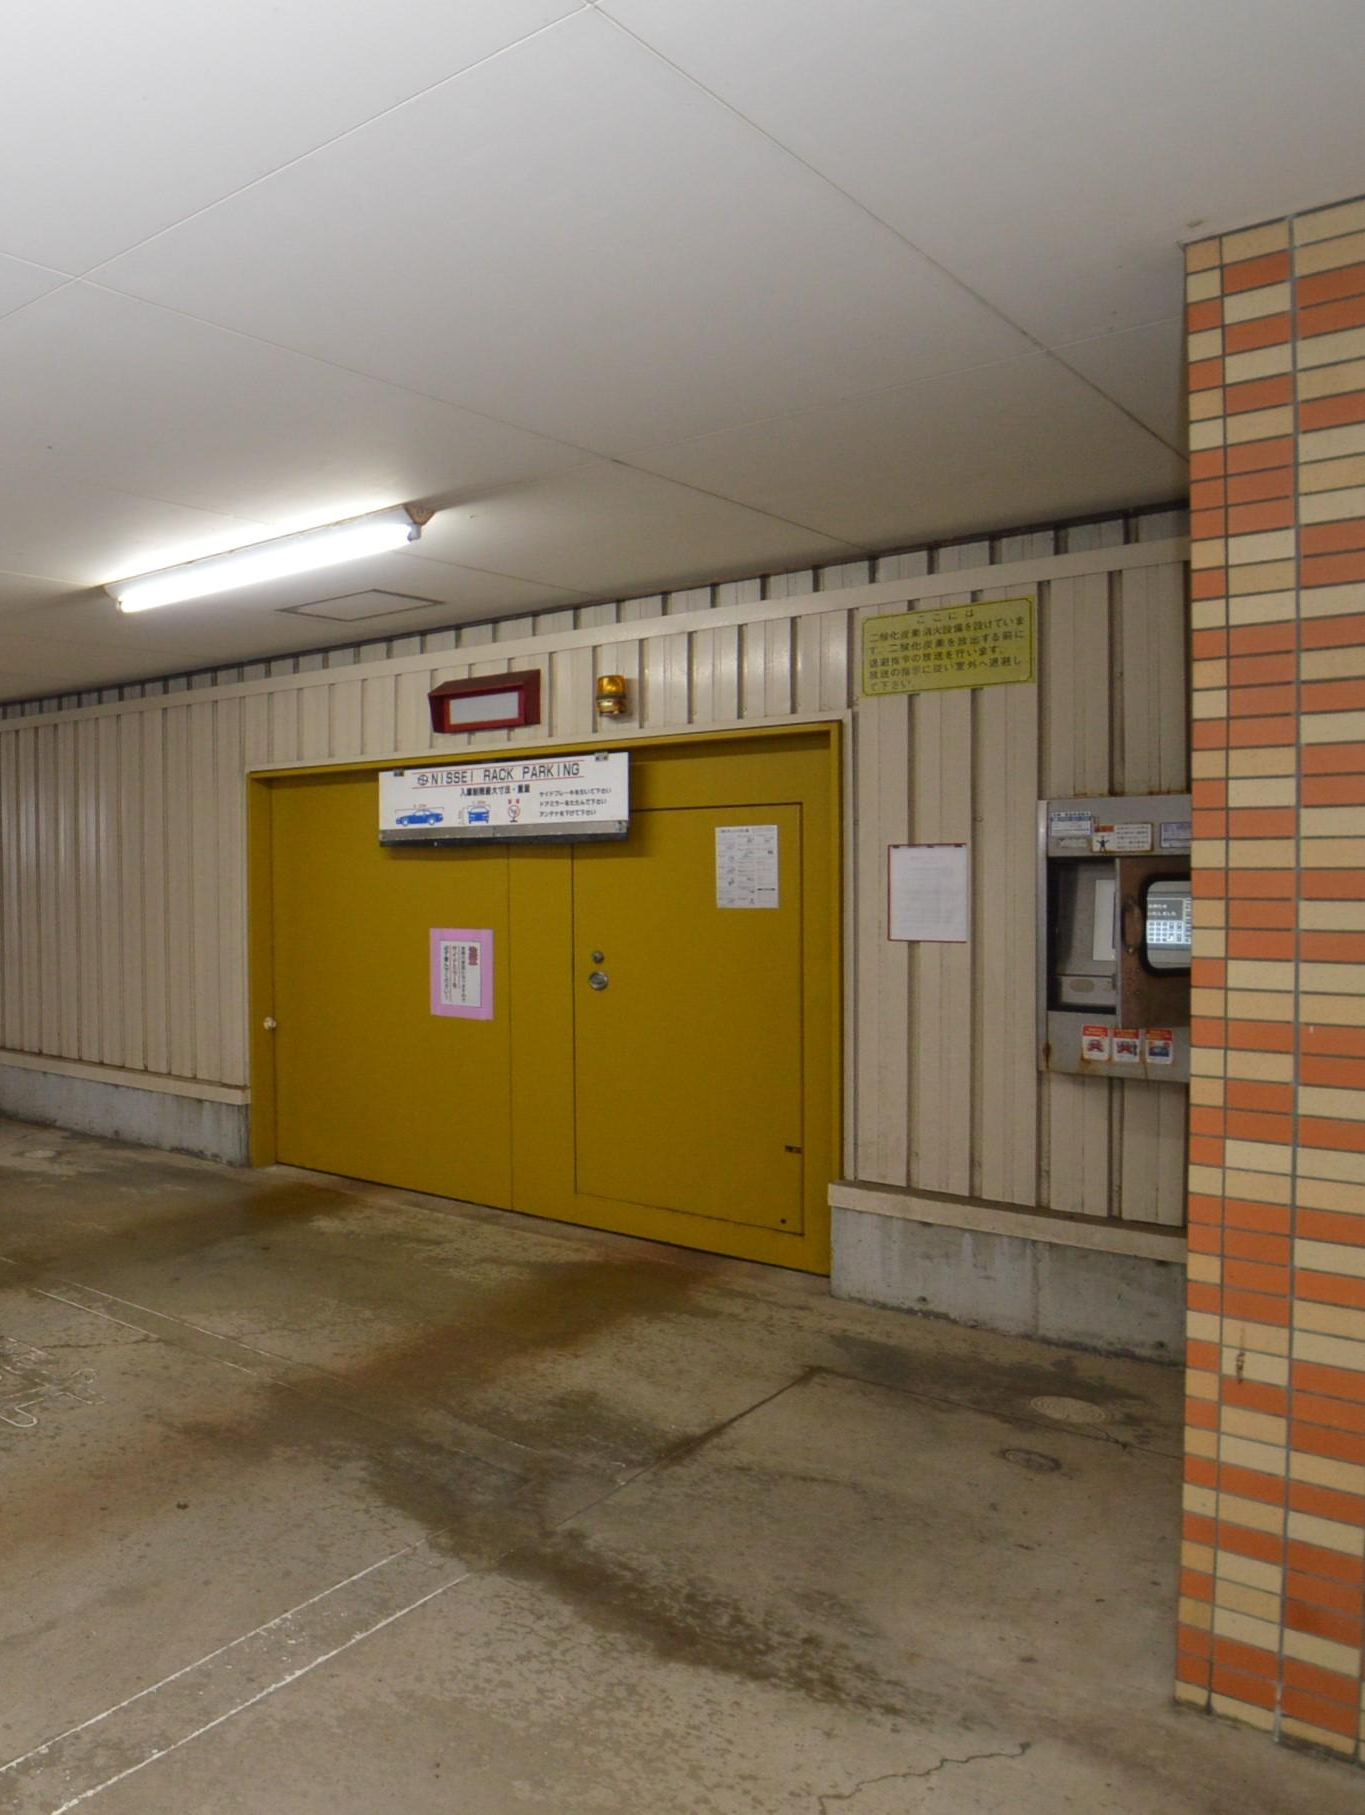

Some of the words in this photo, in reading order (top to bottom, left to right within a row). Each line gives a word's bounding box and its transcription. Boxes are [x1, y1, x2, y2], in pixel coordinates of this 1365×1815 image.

[431, 770, 474, 785] NISSEI
[483, 767, 513, 781] RACK
[522, 762, 580, 779] PARKING
